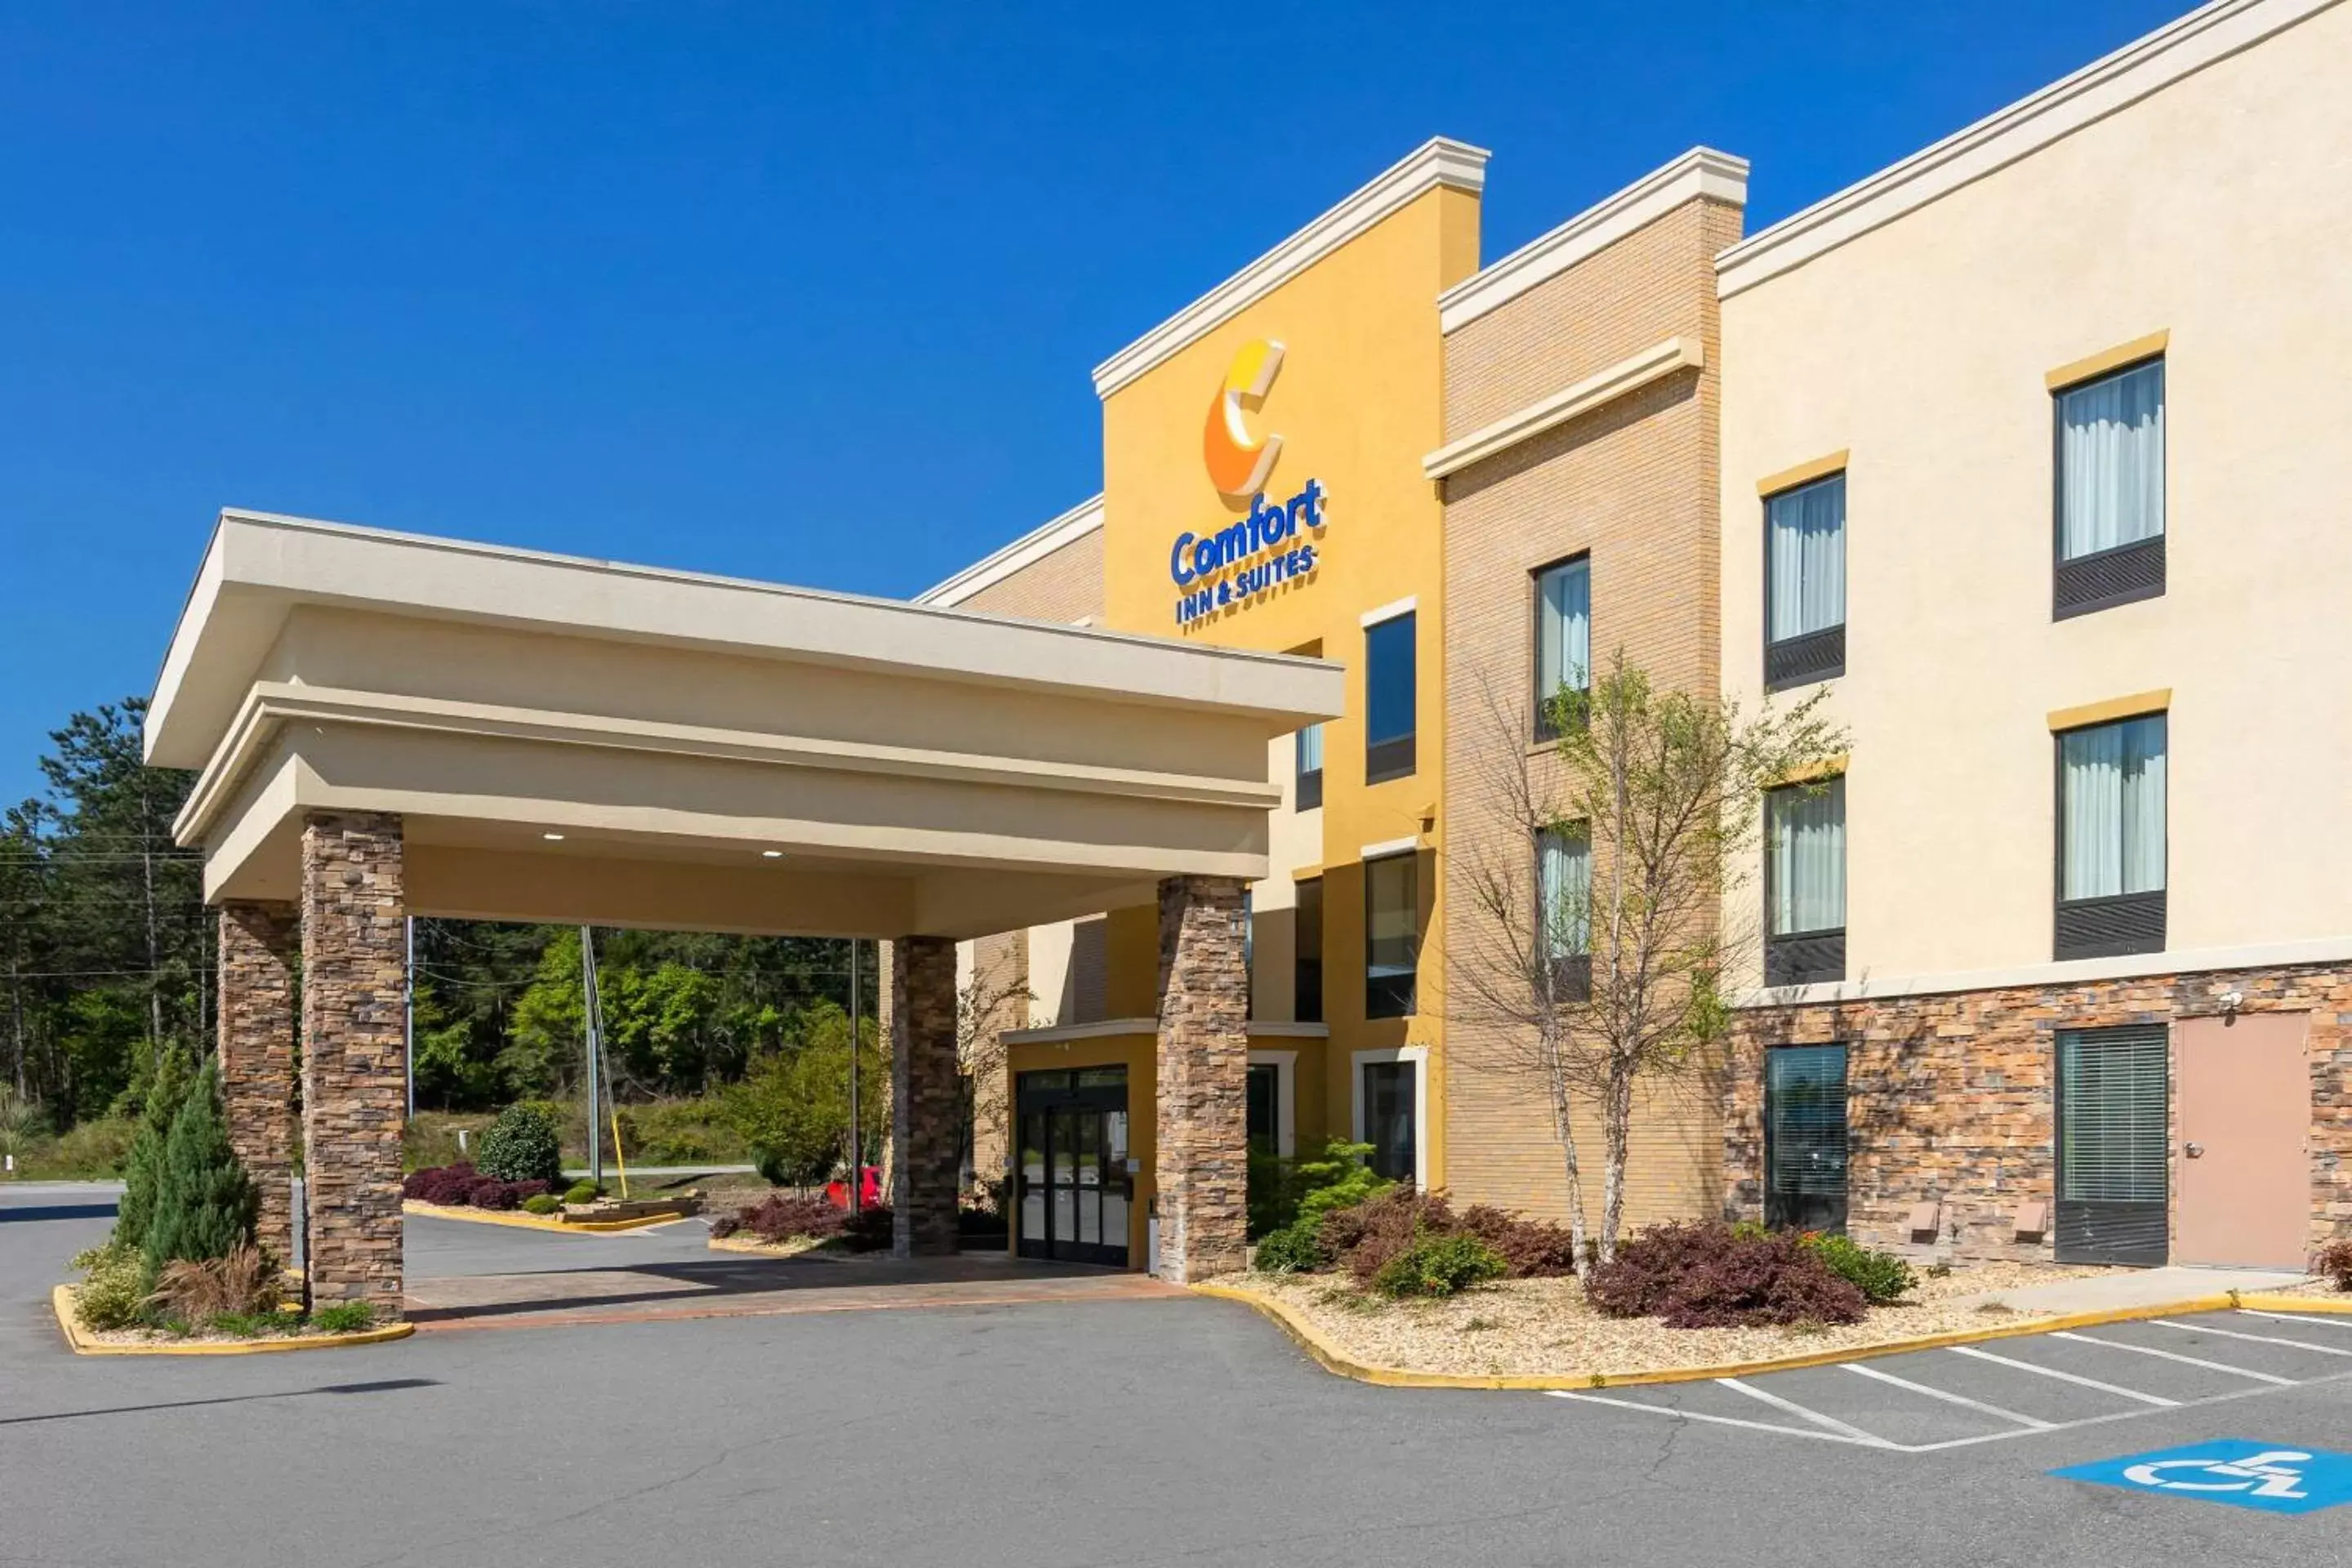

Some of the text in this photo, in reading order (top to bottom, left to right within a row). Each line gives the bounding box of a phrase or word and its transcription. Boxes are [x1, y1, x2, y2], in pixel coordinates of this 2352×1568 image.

[1170, 478, 1325, 586] Comfort
[1176, 545, 1315, 625] INN & SUITES
